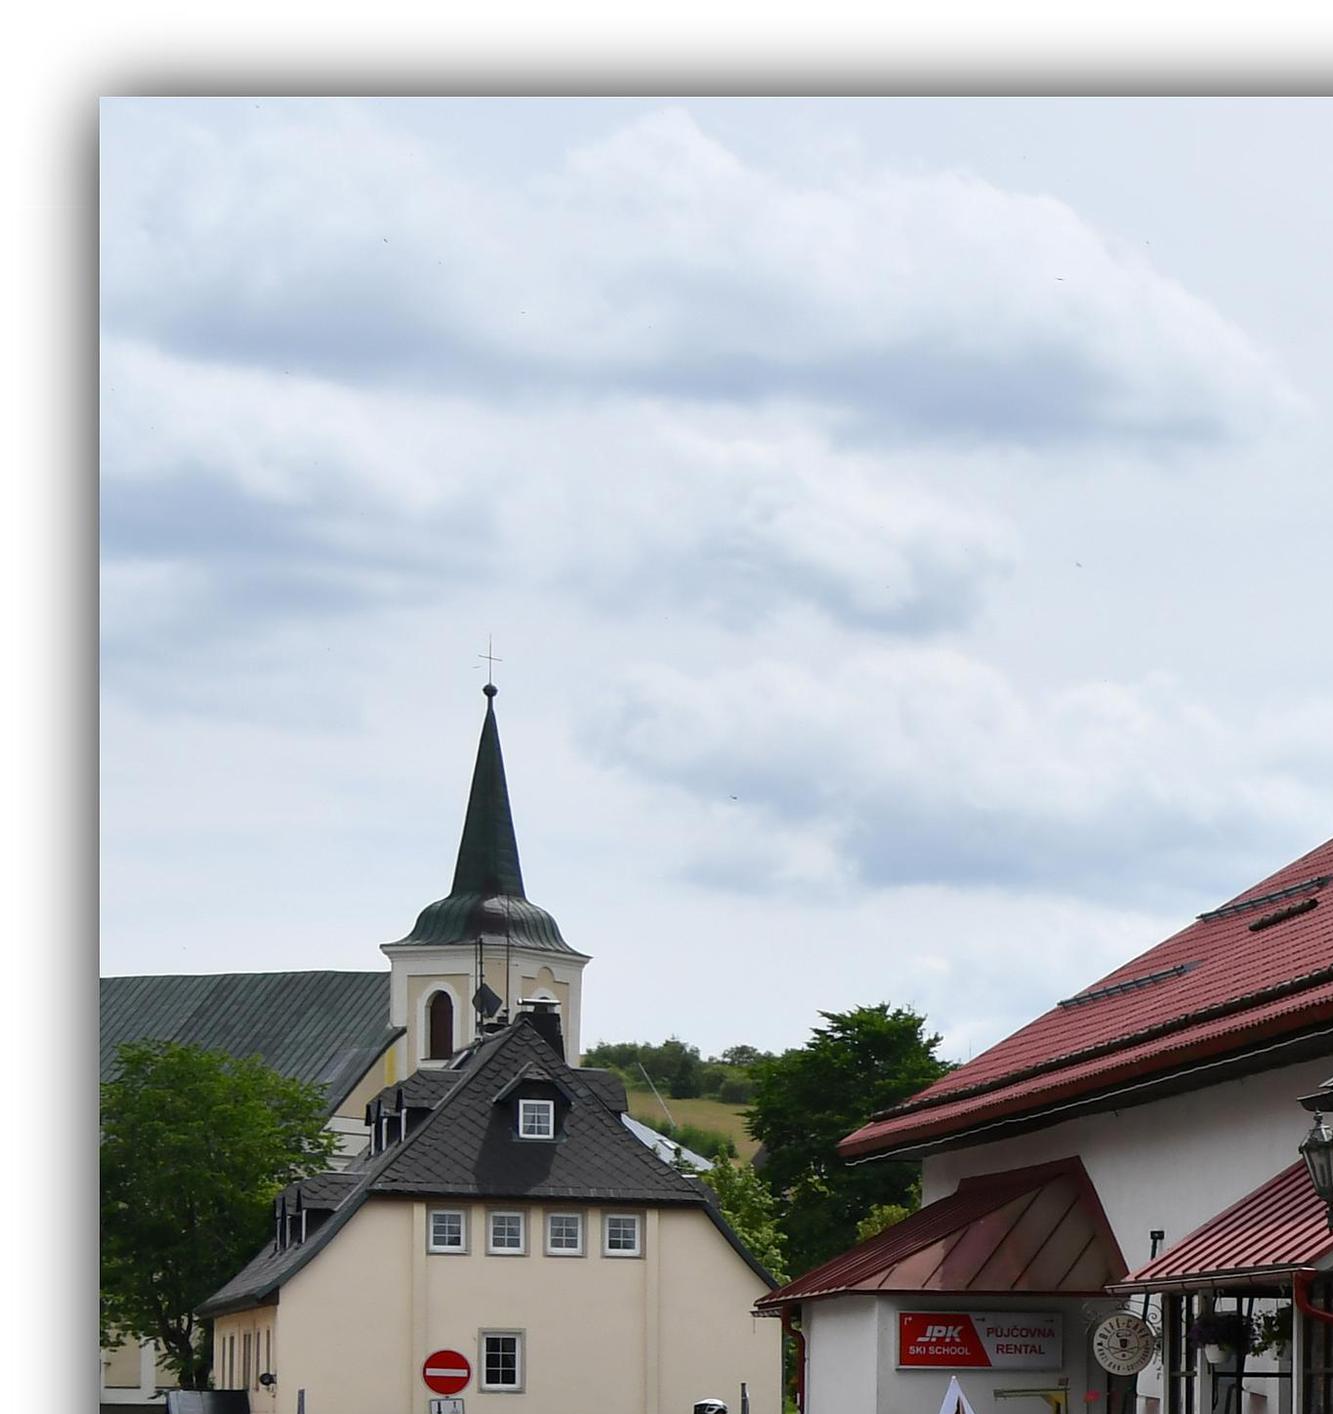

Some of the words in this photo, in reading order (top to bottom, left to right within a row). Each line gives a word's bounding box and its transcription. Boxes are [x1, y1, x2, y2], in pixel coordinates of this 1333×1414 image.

[916, 1325, 964, 1342] JPK
[909, 1345, 926, 1355] SKI
[929, 1345, 971, 1356] SCHOOL
[996, 1343, 1046, 1355] RENTAL
